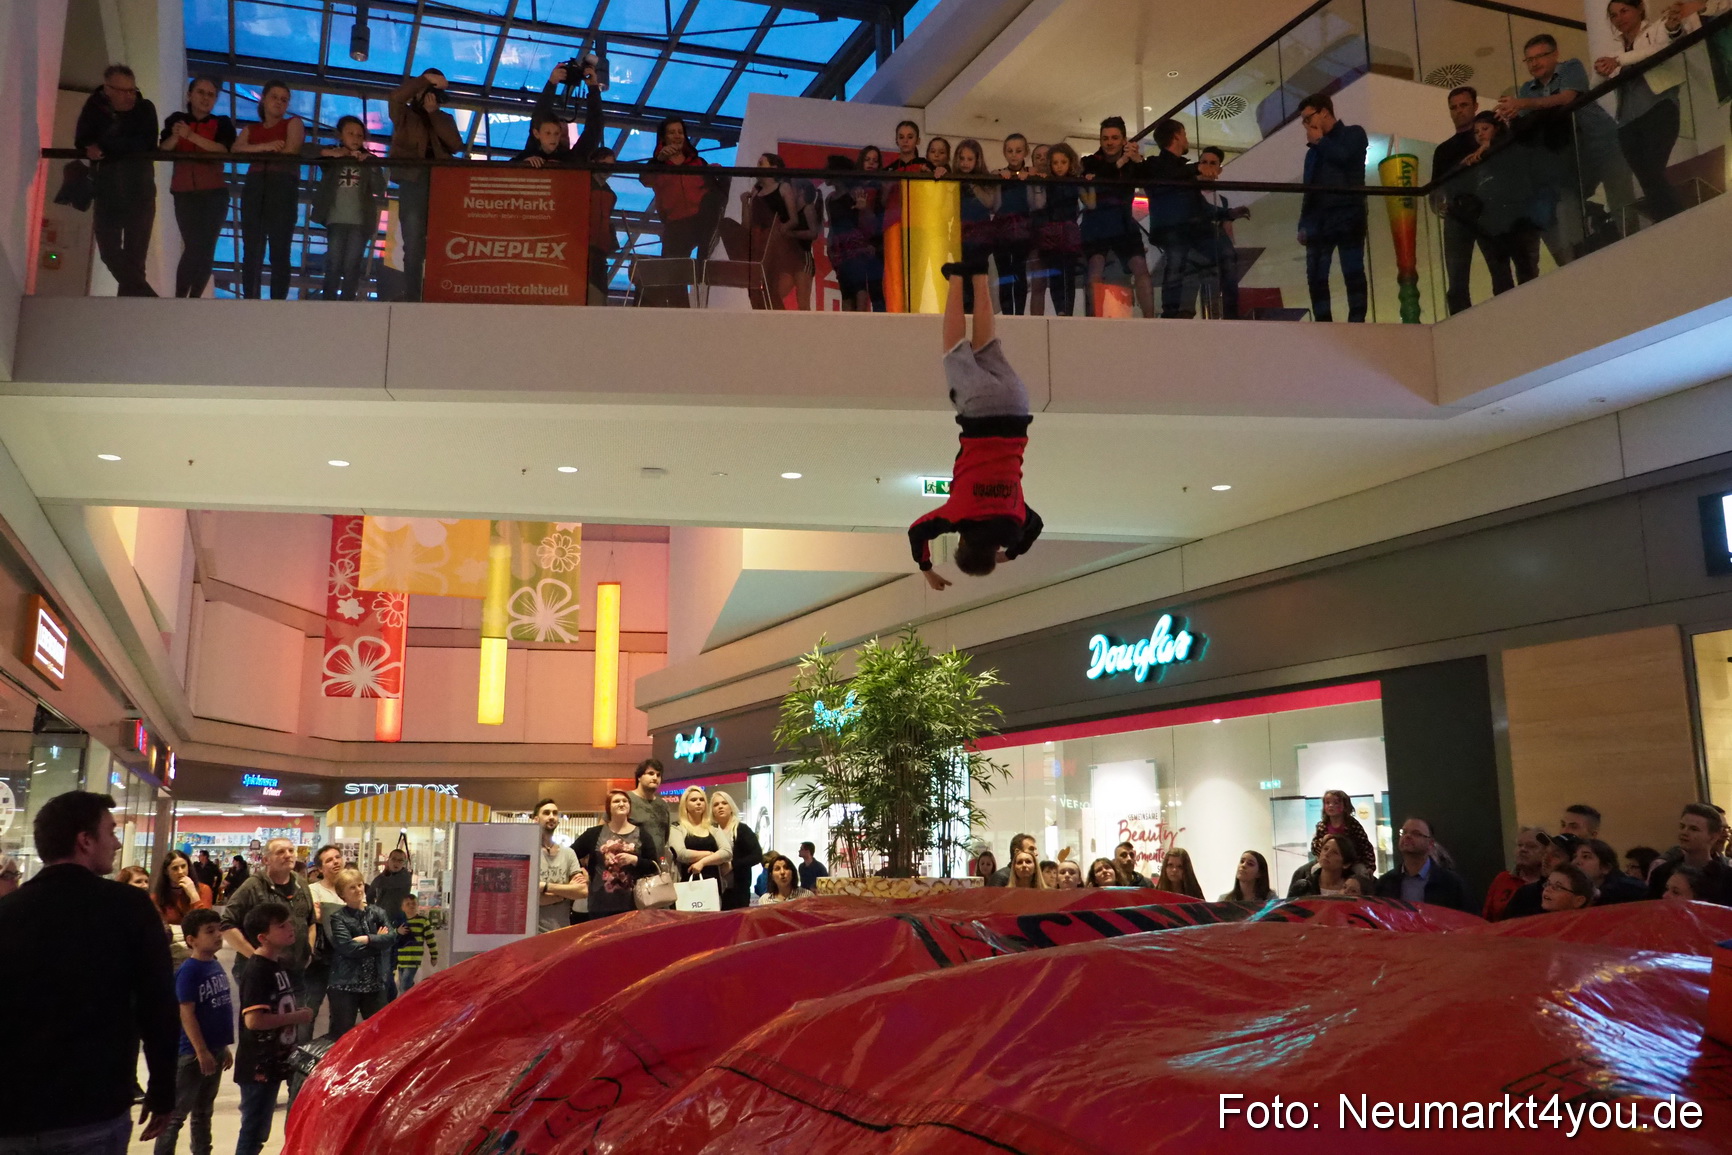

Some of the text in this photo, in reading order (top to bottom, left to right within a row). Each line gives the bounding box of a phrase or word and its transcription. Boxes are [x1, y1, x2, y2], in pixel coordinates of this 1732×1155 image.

[1398, 160, 1415, 209] slshy
[463, 197, 556, 211] NeuerMarkt
[445, 237, 568, 261] CINEPLEX
[453, 283, 569, 297] neumarktaktuell
[1086, 613, 1194, 683] Douglas
